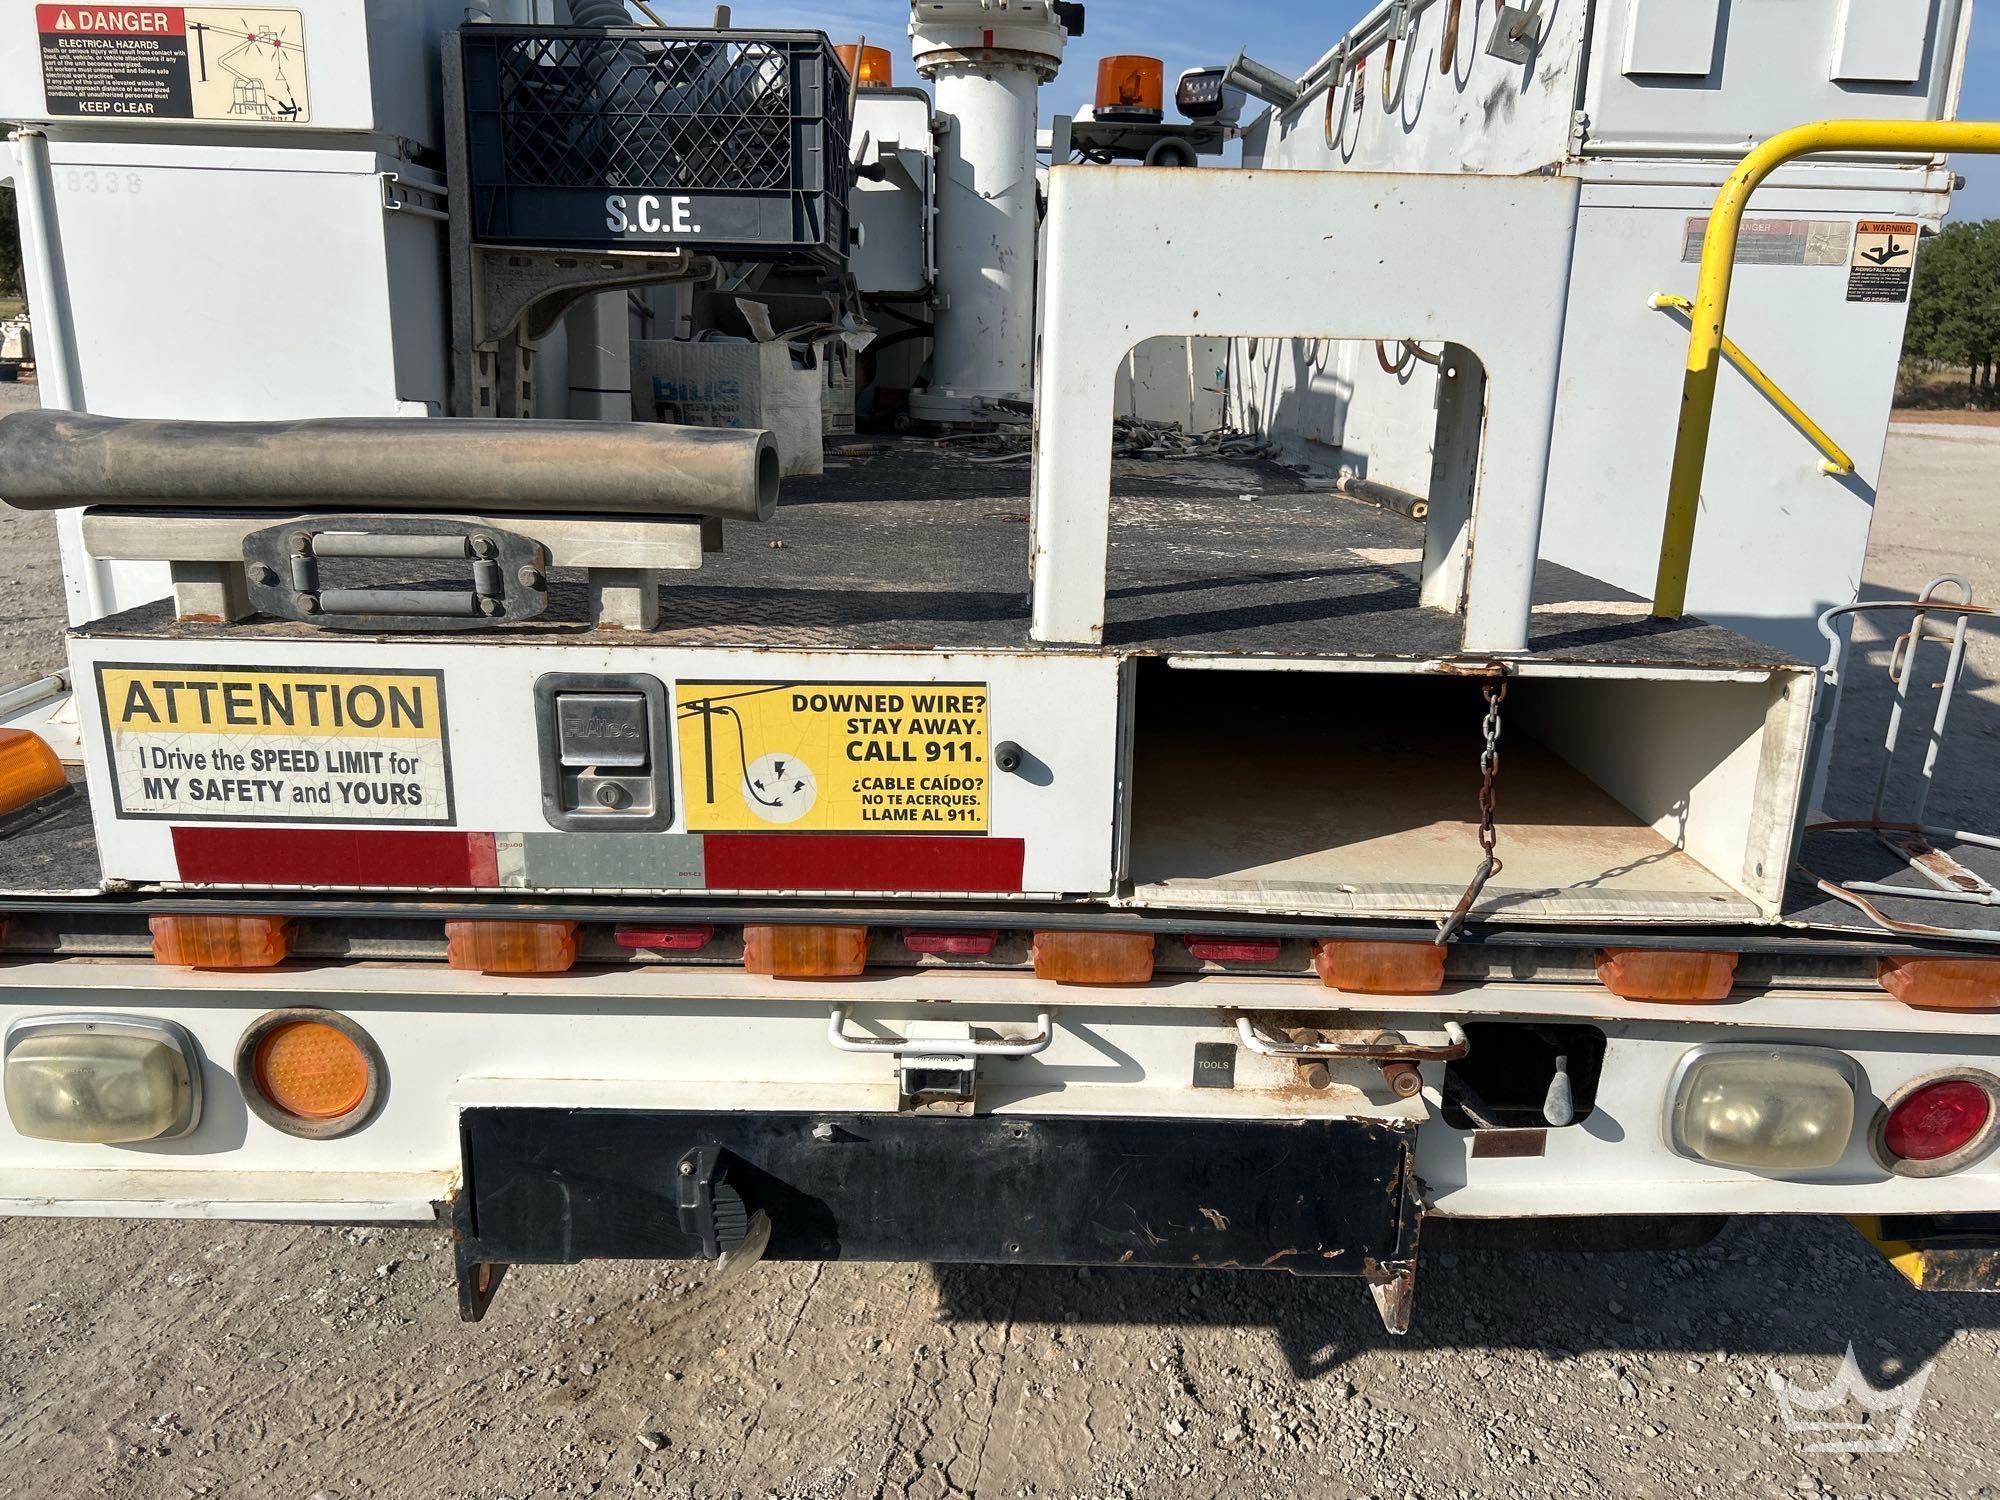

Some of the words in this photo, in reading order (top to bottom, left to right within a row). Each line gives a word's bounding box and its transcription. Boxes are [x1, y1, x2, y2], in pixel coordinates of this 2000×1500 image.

[78, 11, 168, 32] DANGER
[58, 39, 114, 48] ELECTRICAL
[116, 40, 160, 49] HAZARDS
[79, 101, 111, 112] KEEP
[114, 102, 154, 113] CLEAR
[605, 195, 701, 233] S.C.E.
[1873, 224, 1912, 233] WARNING
[121, 679, 424, 729] ATTENTION
[792, 694, 905, 713] DOWNED
[911, 694, 987, 713] WIRE?
[847, 718, 902, 735] STAY
[908, 718, 982, 735] AWAY.
[139, 747, 146, 769] I
[152, 747, 207, 771] Drive
[211, 749, 245, 772] the
[250, 749, 320, 773] SPEED
[326, 751, 384, 775] LIMIT
[388, 752, 420, 775] for
[846, 741, 917, 763] CALL
[925, 741, 982, 763] 911.
[143, 778, 180, 800] MY
[189, 778, 285, 802] SAFETY
[292, 782, 331, 804] and
[339, 782, 423, 806] YOURS
[851, 777, 915, 793] ¿CABLE
[919, 774, 984, 791] CAÍDO?
[862, 795, 884, 805] NO
[887, 794, 903, 805] TE
[906, 794, 982, 808] ACERQUES.
[862, 809, 918, 821] LLAME
[922, 809, 943, 821] AL
[947, 809, 982, 822] 911.
[1198, 1061, 1229, 1069] TOOLS
